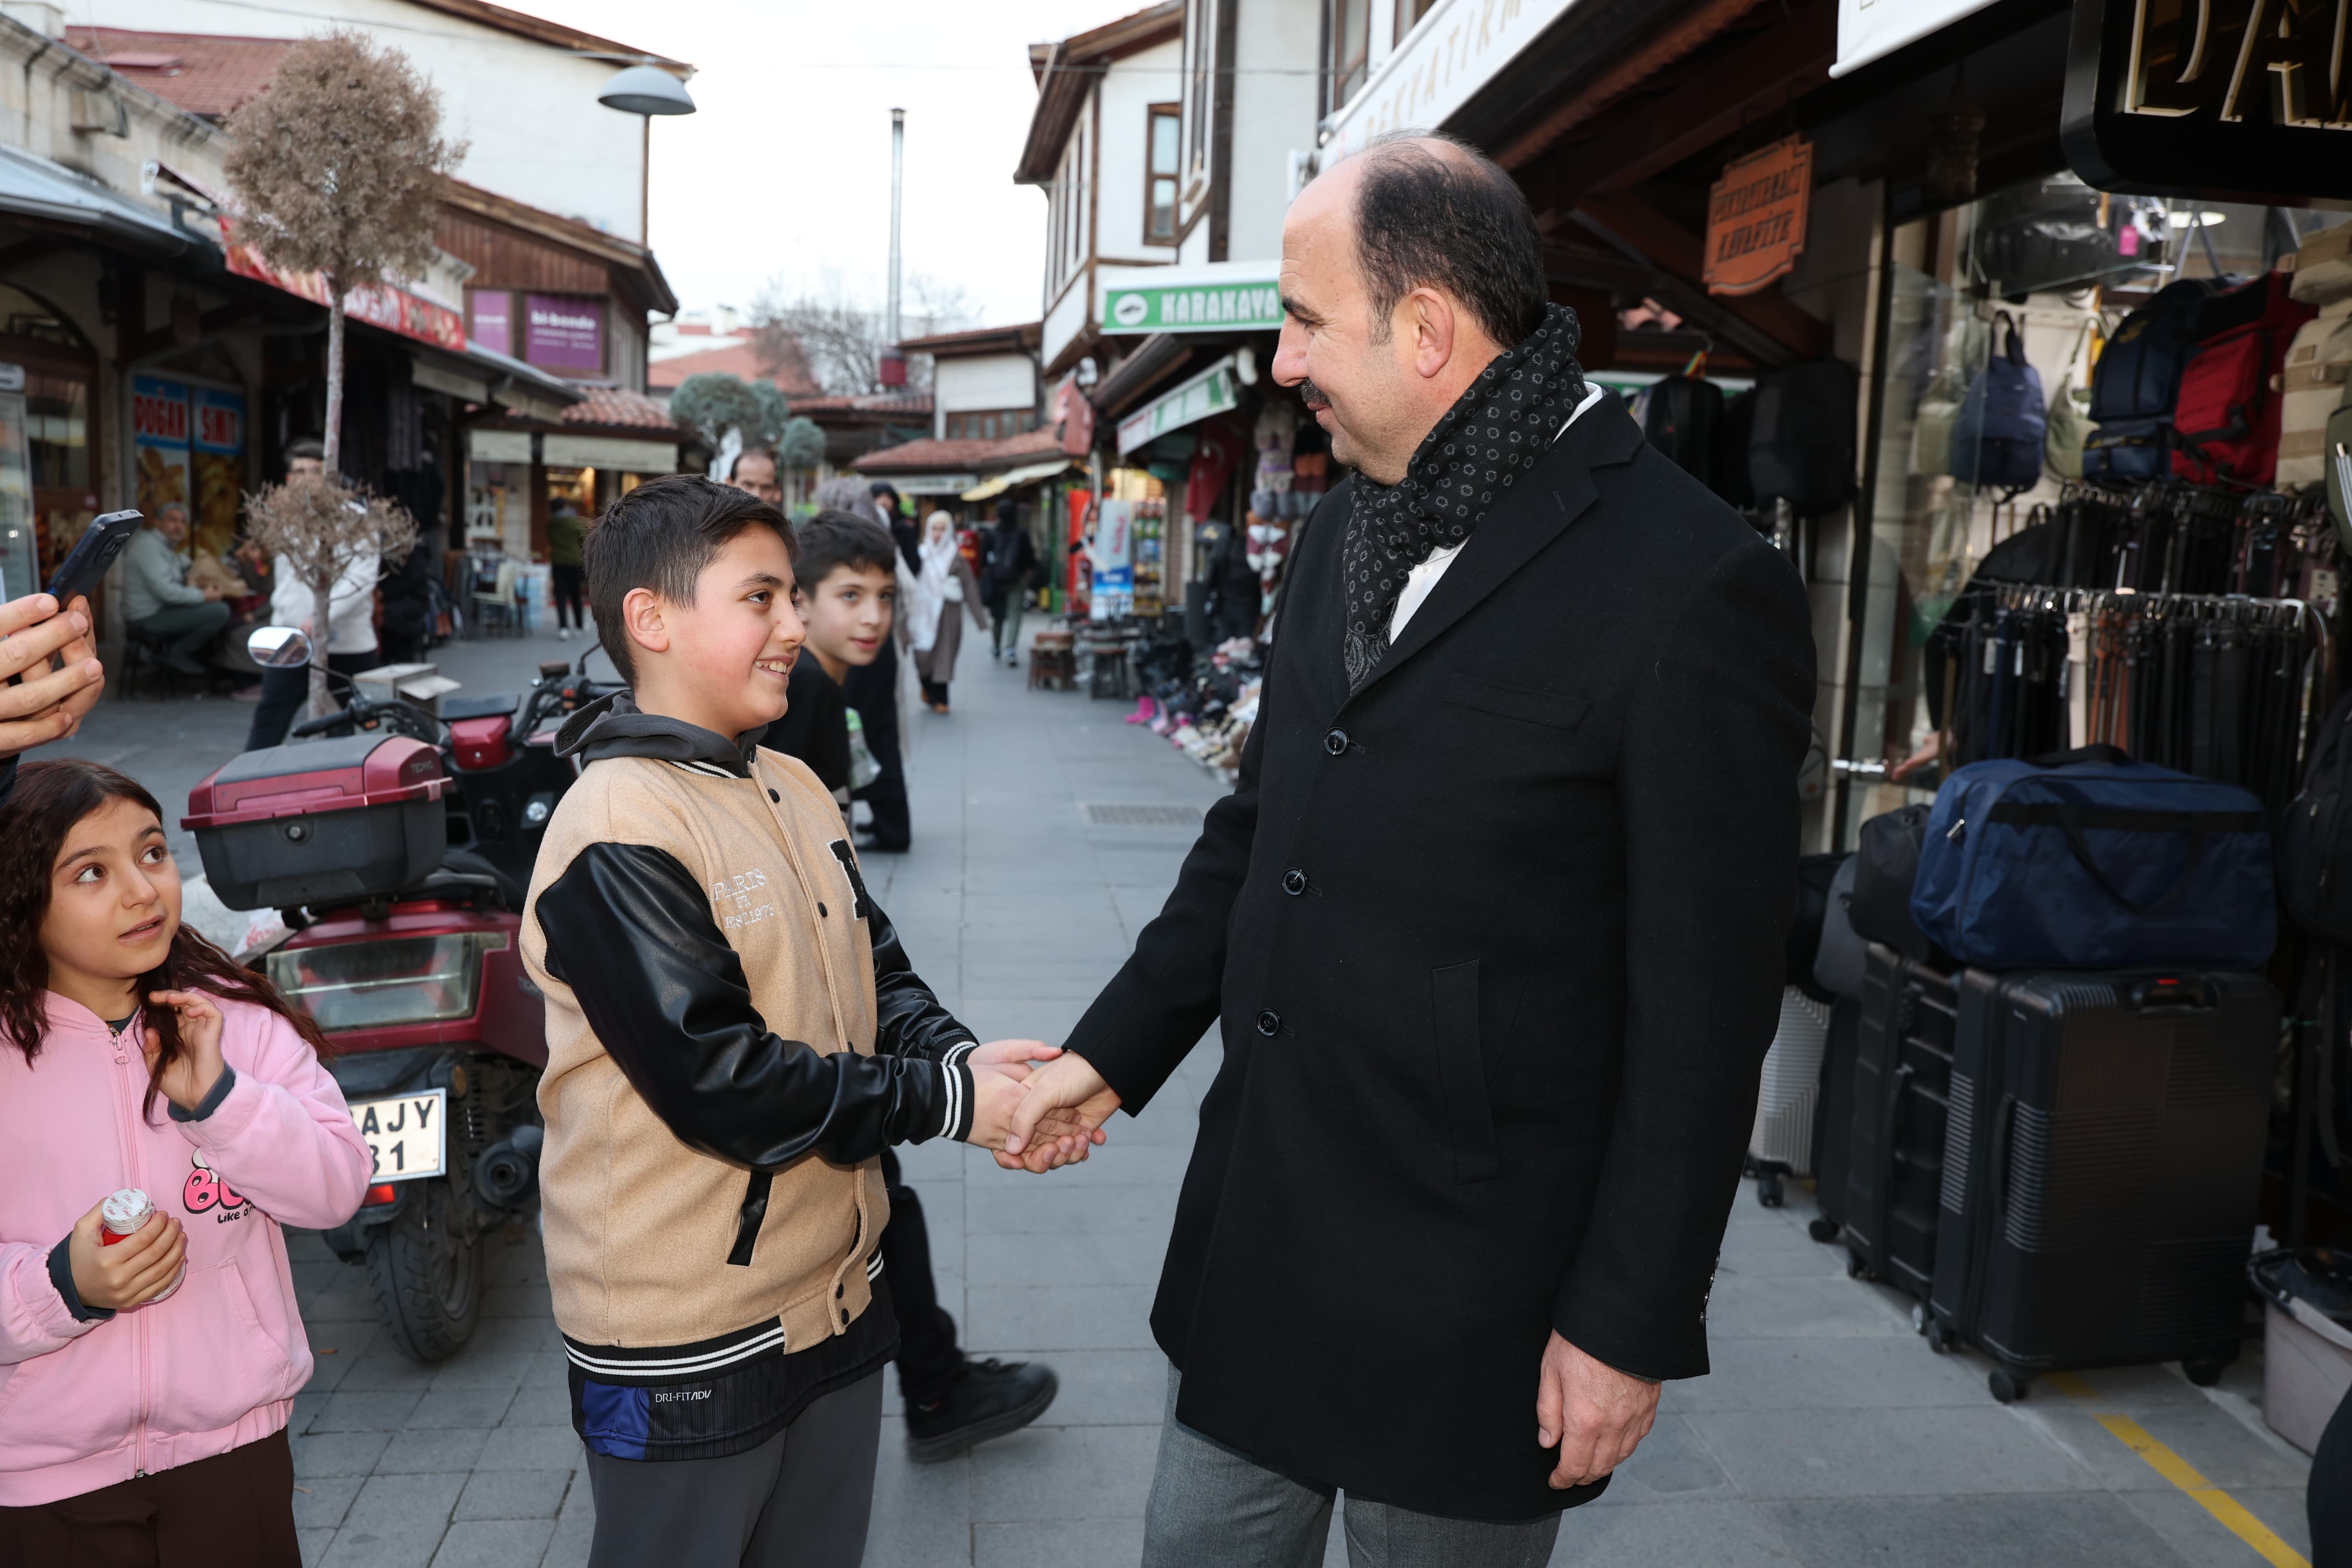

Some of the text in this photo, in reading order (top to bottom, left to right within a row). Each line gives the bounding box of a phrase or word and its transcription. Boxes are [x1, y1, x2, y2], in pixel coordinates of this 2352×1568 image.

[2124, 0, 2352, 130] DA
[1160, 288, 1279, 323] KARAKAYA
[712, 868, 766, 900] PARIS
[735, 895, 752, 909] FR
[362, 1099, 434, 1135] AJY
[217, 1211, 240, 1223] Like
